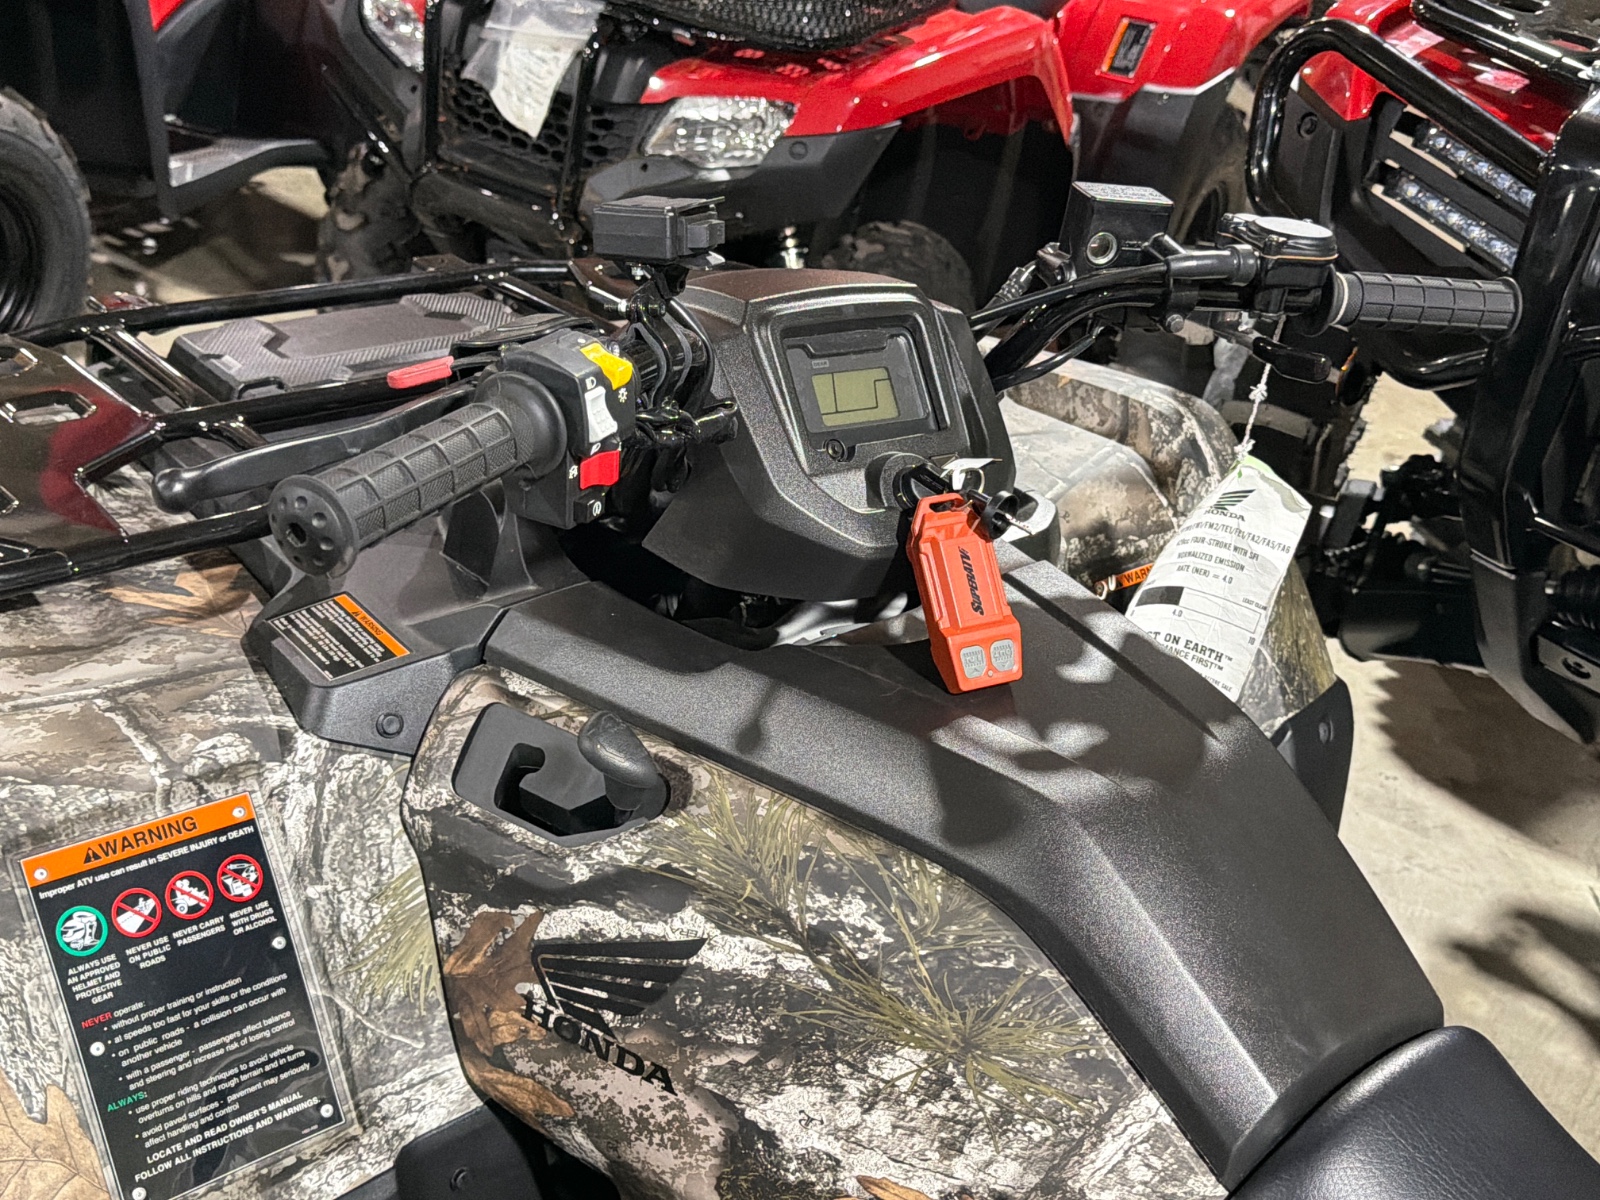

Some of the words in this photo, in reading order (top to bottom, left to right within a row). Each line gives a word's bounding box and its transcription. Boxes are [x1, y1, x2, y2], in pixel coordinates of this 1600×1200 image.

[1204, 509, 1245, 522] HONDA
[1190, 537, 1232, 550] FOUR-STROKE
[1233, 545, 1248, 557] WITH
[1249, 552, 1259, 561] SFI
[1177, 552, 1213, 563] NORMALIZED
[1214, 558, 1245, 572] EMISSION
[958, 546, 985, 616] SUPERATV
[1176, 564, 1190, 573] RATE
[1191, 567, 1210, 577] (NER)
[1222, 575, 1233, 584] 4.0
[1242, 597, 1254, 606] LEAST
[361, 616, 383, 636] WARNING
[1172, 608, 1183, 617] 4.0
[1248, 636, 1256, 645] 10
[1164, 633, 1181, 645] ON
[1221, 682, 1232, 692] SALE
[98, 816, 197, 857] WARNING
[38, 882, 75, 899] Improper
[76, 875, 93, 887] ATV
[94, 872, 110, 882] use
[109, 867, 125, 877] can
[125, 859, 148, 872] result
[147, 857, 157, 865] in
[156, 845, 190, 862] SEVERE
[189, 836, 217, 851] INJURY
[218, 834, 227, 842] or
[227, 825, 254, 839] DEATH
[229, 906, 253, 918] NEVER
[254, 900, 269, 910] USE
[231, 916, 249, 926] WITH
[249, 907, 273, 920] DRUGS
[172, 924, 198, 938] NEVER
[198, 915, 223, 929] CARRY
[176, 924, 225, 946] PASSENGERS
[233, 926, 244, 935] OR
[245, 915, 277, 931] ALCOHOL
[125, 941, 152, 955] NEVER
[152, 935, 169, 946] USE
[128, 954, 141, 963] ON
[142, 943, 171, 959] PUBLIC
[67, 975, 78, 985] AN
[79, 961, 120, 980] APPROVED
[68, 959, 100, 975] ALWAYS
[100, 953, 116, 964] USE
[139, 955, 166, 969] ROADS
[71, 976, 102, 992] HELMET
[104, 970, 120, 981] AND
[74, 978, 122, 1000] PROTECTIVE
[91, 991, 113, 1004] GEAR
[111, 1014, 140, 1030] without
[140, 1005, 165, 1020] proper
[166, 994, 195, 1009] training
[195, 990, 203, 999] or
[204, 976, 242, 995] instruction
[114, 1034, 122, 1043] at
[123, 1024, 152, 1040] speeds
[152, 1019, 165, 1029] too
[166, 1012, 181, 1023] fast
[181, 1009, 192, 1017] for
[193, 1002, 210, 1015] your
[210, 995, 230, 1007] skills
[230, 991, 238, 999] or
[238, 986, 251, 996] the
[251, 972, 287, 991] conditions
[81, 1011, 112, 1028] NEVER
[113, 1000, 146, 1017] operate:
[117, 1047, 129, 1057] on
[132, 1037, 158, 1052] public
[161, 1027, 185, 1040] roads
[200, 1008, 232, 1025] collision
[232, 1002, 248, 1013] can
[248, 993, 269, 1007] occur
[270, 987, 286, 998] with
[121, 1049, 152, 1067] another
[153, 1038, 182, 1054] vehicle
[125, 1069, 142, 1080] with
[143, 1066, 149, 1074] a
[150, 1050, 190, 1072] passenger
[198, 1030, 241, 1053] passengers
[241, 1021, 262, 1034] affect
[262, 1010, 291, 1026] balance
[128, 1078, 144, 1090] and
[145, 1067, 176, 1084] steering
[177, 1059, 192, 1071] and
[192, 1047, 224, 1064] increase
[225, 1041, 239, 1051] risk
[239, 1036, 248, 1046] of
[248, 1029, 271, 1042] losing
[270, 1018, 295, 1033] control
[520, 992, 678, 1096] HONDA
[135, 1103, 150, 1114] use
[150, 1092, 176, 1109] proper
[177, 1083, 199, 1096] riding
[198, 1066, 239, 1087] techniques
[239, 1063, 247, 1071] to
[248, 1053, 268, 1067] avoid
[268, 1044, 294, 1058] vehicle
[137, 1104, 174, 1124] overturns
[174, 1099, 185, 1108] on
[185, 1093, 202, 1104] hills
[202, 1085, 217, 1097] and
[217, 1077, 239, 1090] rough
[239, 1067, 263, 1081] terrain
[264, 1059, 278, 1071] and
[278, 1057, 286, 1065] in
[286, 1050, 305, 1062] turns
[107, 1091, 147, 1112] ALWAYS:
[141, 1123, 163, 1138] avoid
[163, 1112, 187, 1130] paved
[187, 1100, 219, 1118] surfaces
[226, 1081, 262, 1103] pavement
[262, 1075, 278, 1086] may
[279, 1062, 310, 1080] seriously
[144, 1133, 166, 1148] affect
[166, 1120, 199, 1138] handling
[199, 1112, 214, 1124] and
[214, 1101, 239, 1118] control
[146, 1142, 182, 1163] LOCATE
[184, 1134, 202, 1147] AND
[203, 1123, 227, 1138] READ
[228, 1105, 267, 1127] OWNER'S
[267, 1091, 303, 1111] MANUAL
[134, 1160, 172, 1182] FOLLOW
[174, 1153, 191, 1165] ALL
[192, 1124, 254, 1157] INSTRUCTIONS
[255, 1116, 273, 1129] AND
[273, 1096, 320, 1120] WARNINGS.
